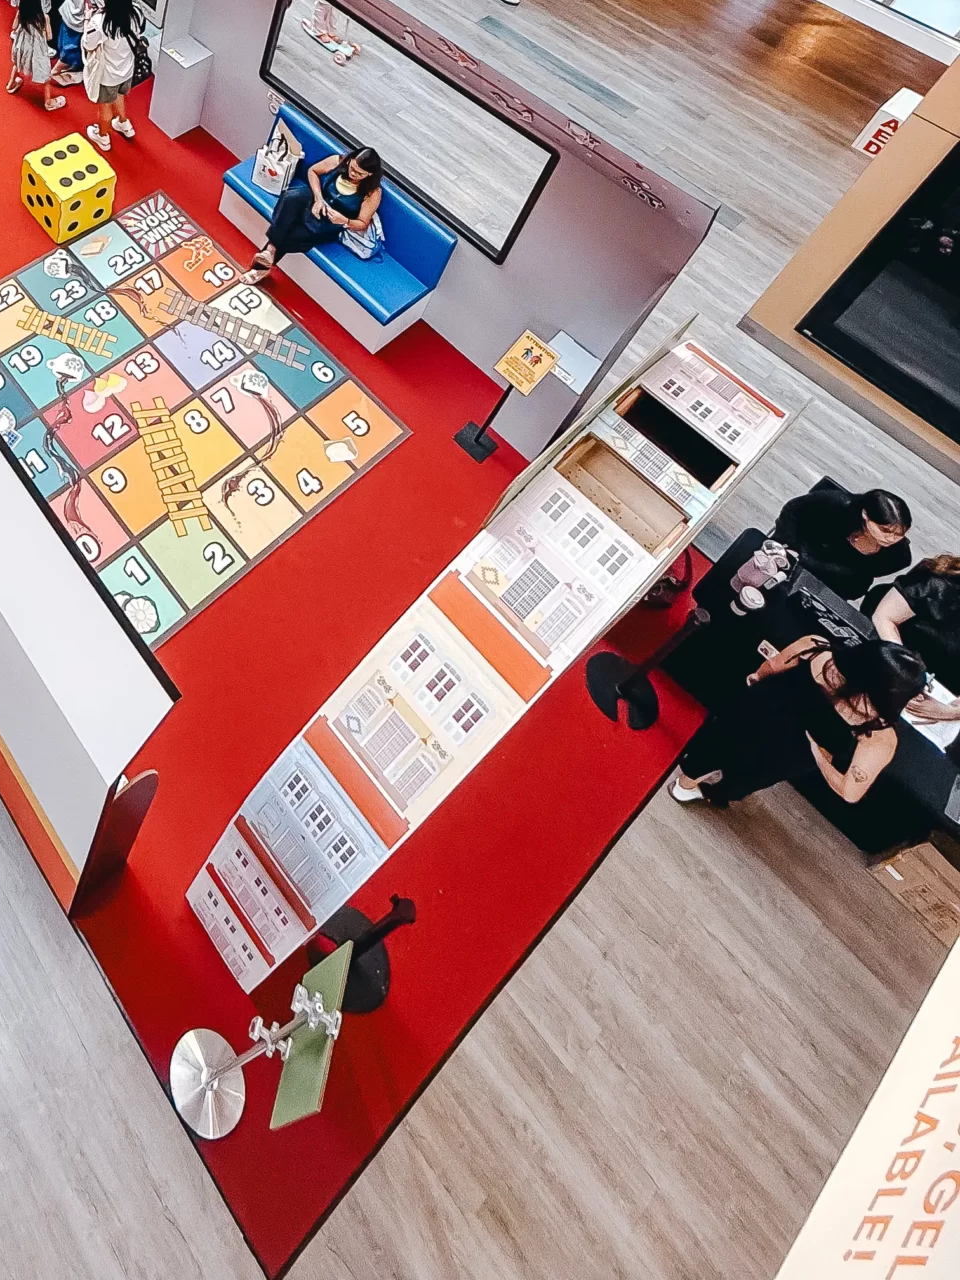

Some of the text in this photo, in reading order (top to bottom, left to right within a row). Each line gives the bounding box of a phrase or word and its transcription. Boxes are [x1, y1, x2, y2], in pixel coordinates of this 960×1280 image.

[863, 118, 899, 155] AED
[136, 208, 171, 231] YOU
[108, 246, 144, 275] 24
[134, 268, 164, 296] 17
[203, 262, 235, 288] 16
[50, 280, 87, 310] 23
[229, 288, 262, 315] 15
[84, 300, 118, 327] 18
[8, 345, 43, 373] 19
[200, 341, 236, 371] 14
[525, 335, 555, 360] ATTENTION
[124, 351, 160, 381] 13
[311, 361, 335, 383] 6
[210, 387, 235, 414] 7
[92, 413, 132, 447] 12
[183, 409, 210, 434] 8
[342, 410, 370, 437] 5
[101, 466, 127, 493] 9
[247, 478, 275, 506] 3
[296, 468, 323, 496] 4
[75, 533, 101, 562] 0
[203, 542, 235, 575] 2
[124, 556, 150, 585] 1
